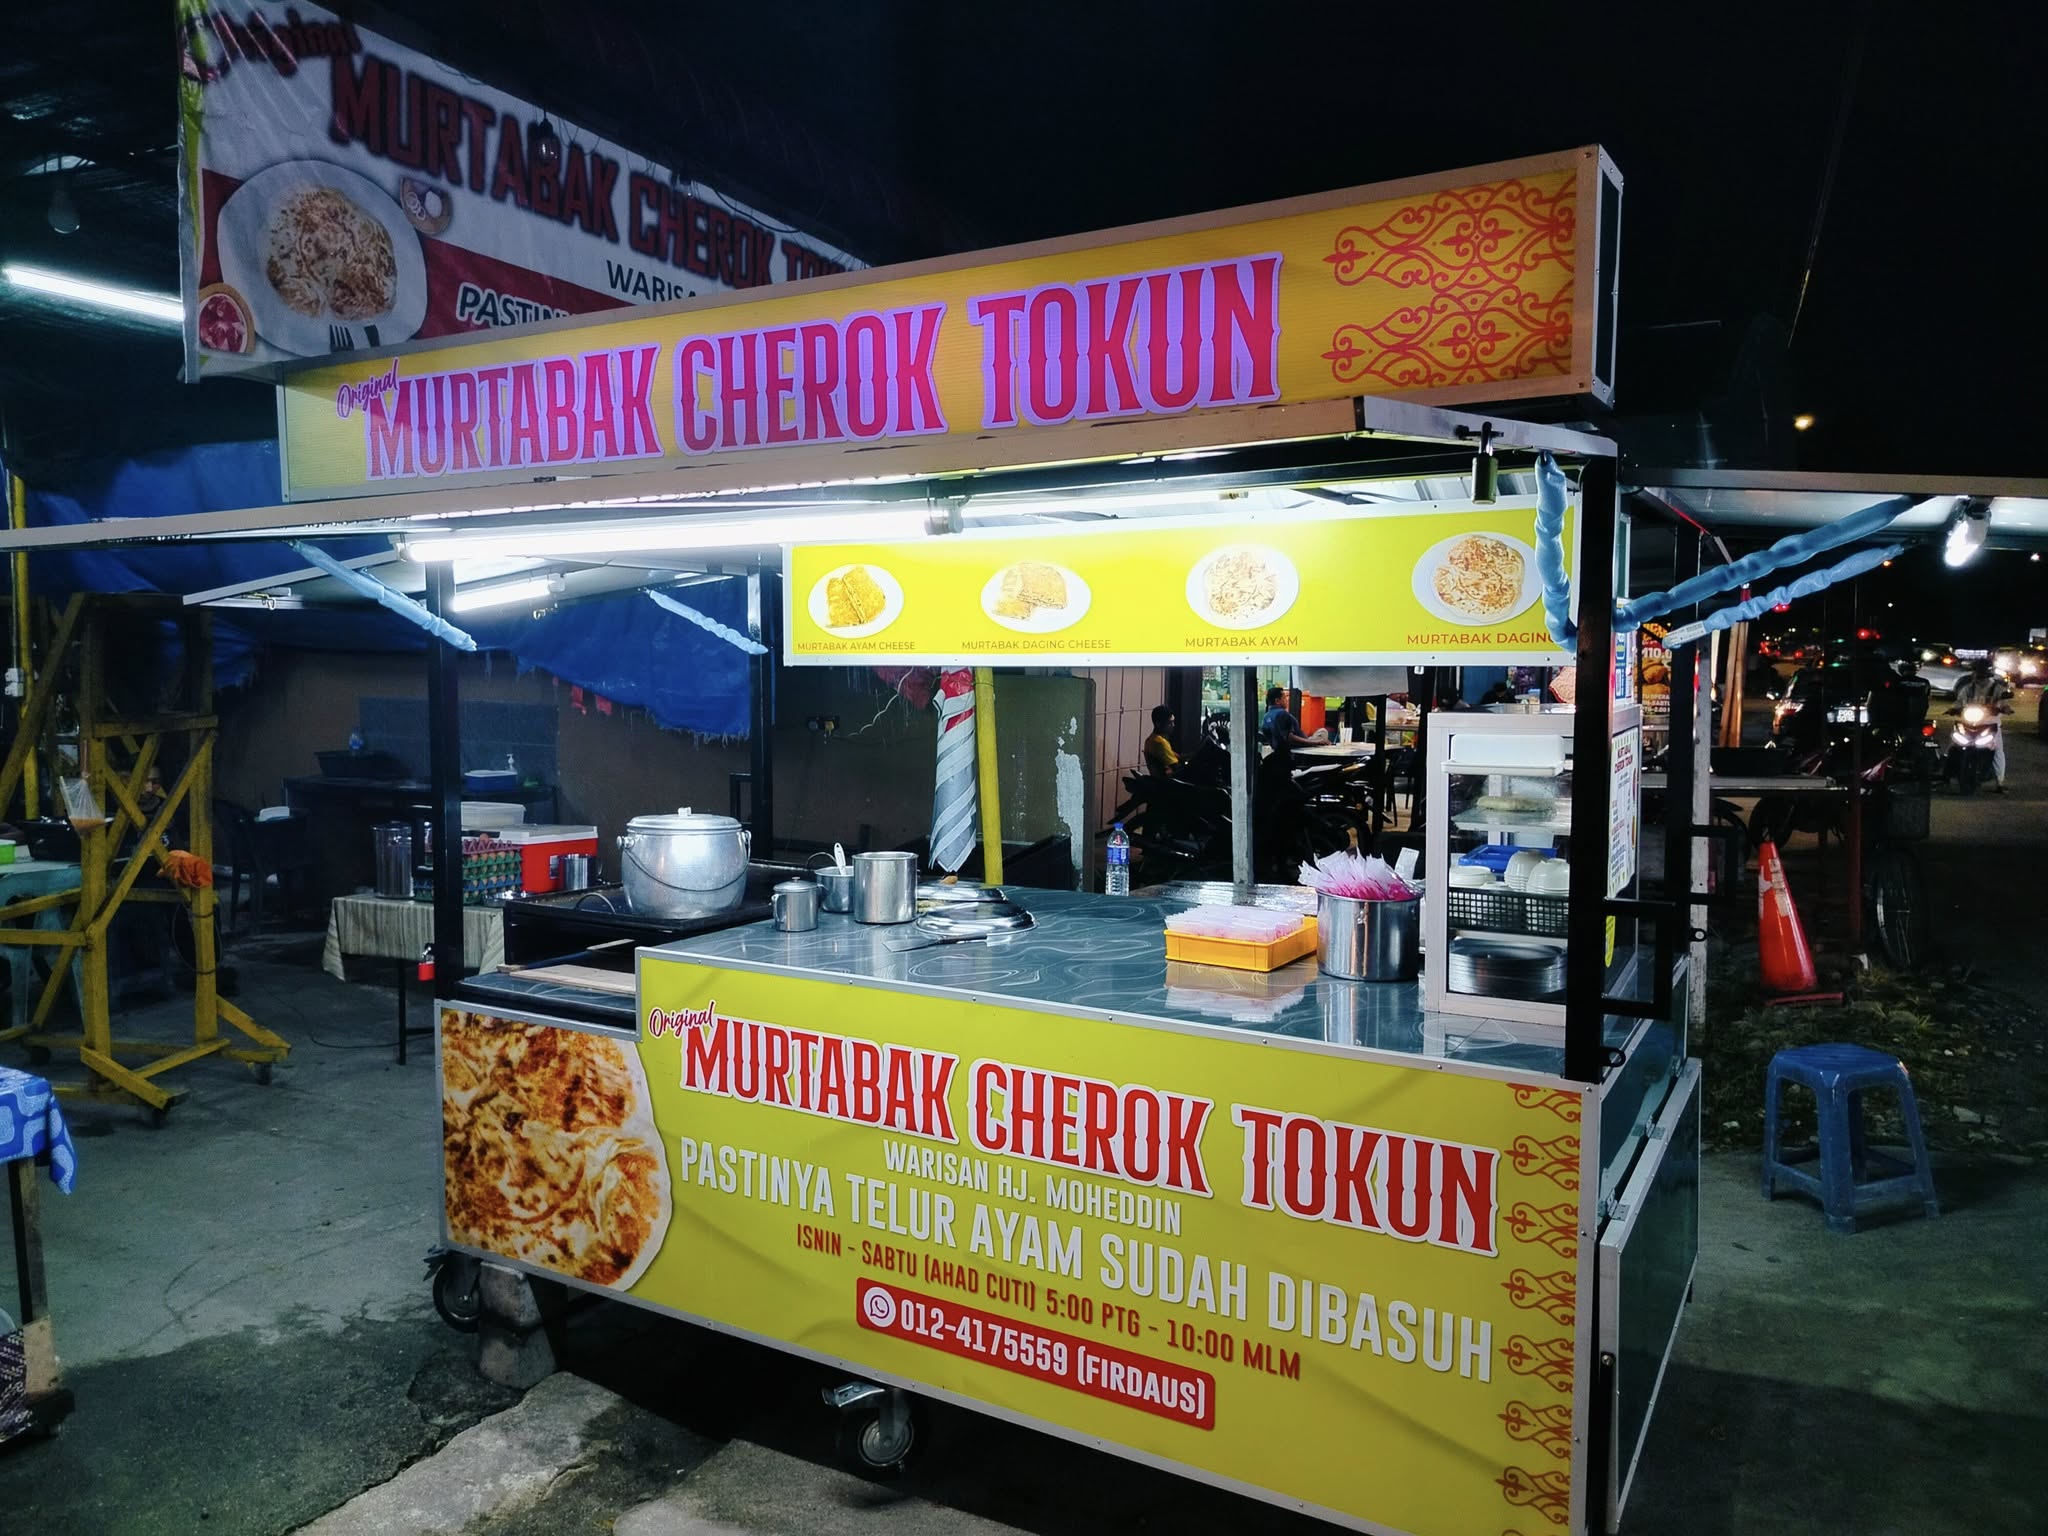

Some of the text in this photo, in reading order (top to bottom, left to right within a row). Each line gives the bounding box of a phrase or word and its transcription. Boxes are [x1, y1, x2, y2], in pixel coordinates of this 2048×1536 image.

[327, 52, 774, 289] MURTABAK CHEROK
[337, 357, 398, 418] Original
[368, 258, 1280, 477] MURTABAK CHEROK TOKUN
[797, 641, 915, 651] MURTABAK AYAM CHEESE
[962, 639, 1111, 650] MURTABAK DAGING CHEESE
[1185, 636, 1298, 648] MURTABAK AYAM
[1407, 633, 1491, 645] MURTABAK
[649, 1001, 715, 1037] Original
[685, 1017, 1496, 1252] MURTABAK CHEROK TOKUN
[884, 1139, 1182, 1236] WARISAN HJ. MOHEDDIN
[681, 1137, 1492, 1383] PASTINYA TELUR AYAM SUDAH DIBASUH
[797, 1224, 842, 1257] ISNIN
[862, 1241, 917, 1278] SABTU
[924, 1253, 979, 1293] (AHAD
[986, 1271, 1036, 1312] CUTI)
[1046, 1287, 1093, 1323] 5:00
[1102, 1303, 1140, 1336] PTG
[1167, 1319, 1233, 1362] 10:00
[1243, 1341, 1300, 1380] MLM
[901, 1299, 1206, 1420] 012-4175559 (FIRDAUS)
